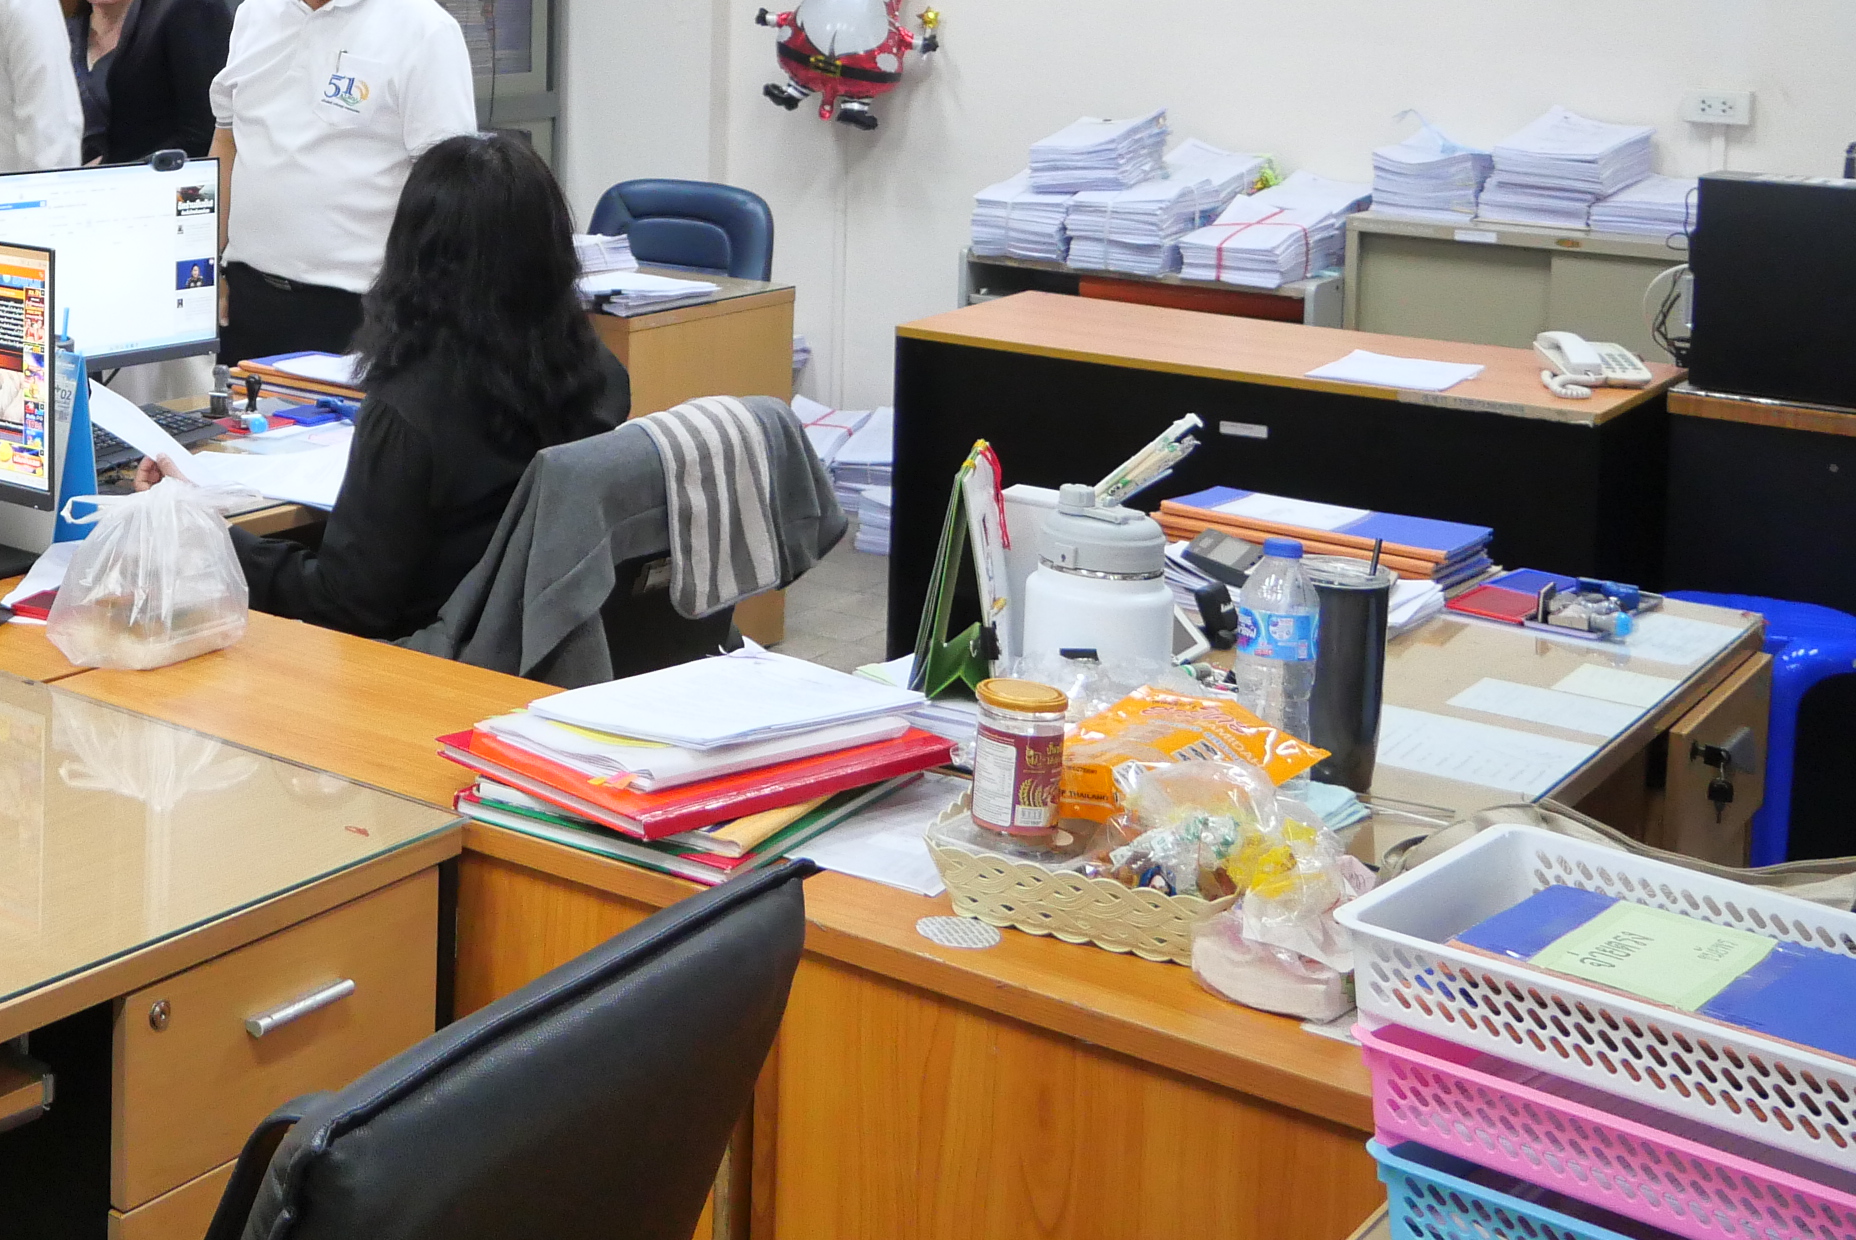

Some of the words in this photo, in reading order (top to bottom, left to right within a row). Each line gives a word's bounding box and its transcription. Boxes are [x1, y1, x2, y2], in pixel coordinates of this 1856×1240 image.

[1069, 789, 1110, 801] THAILAND
[1566, 930, 1656, 969] จ่ายตรง
